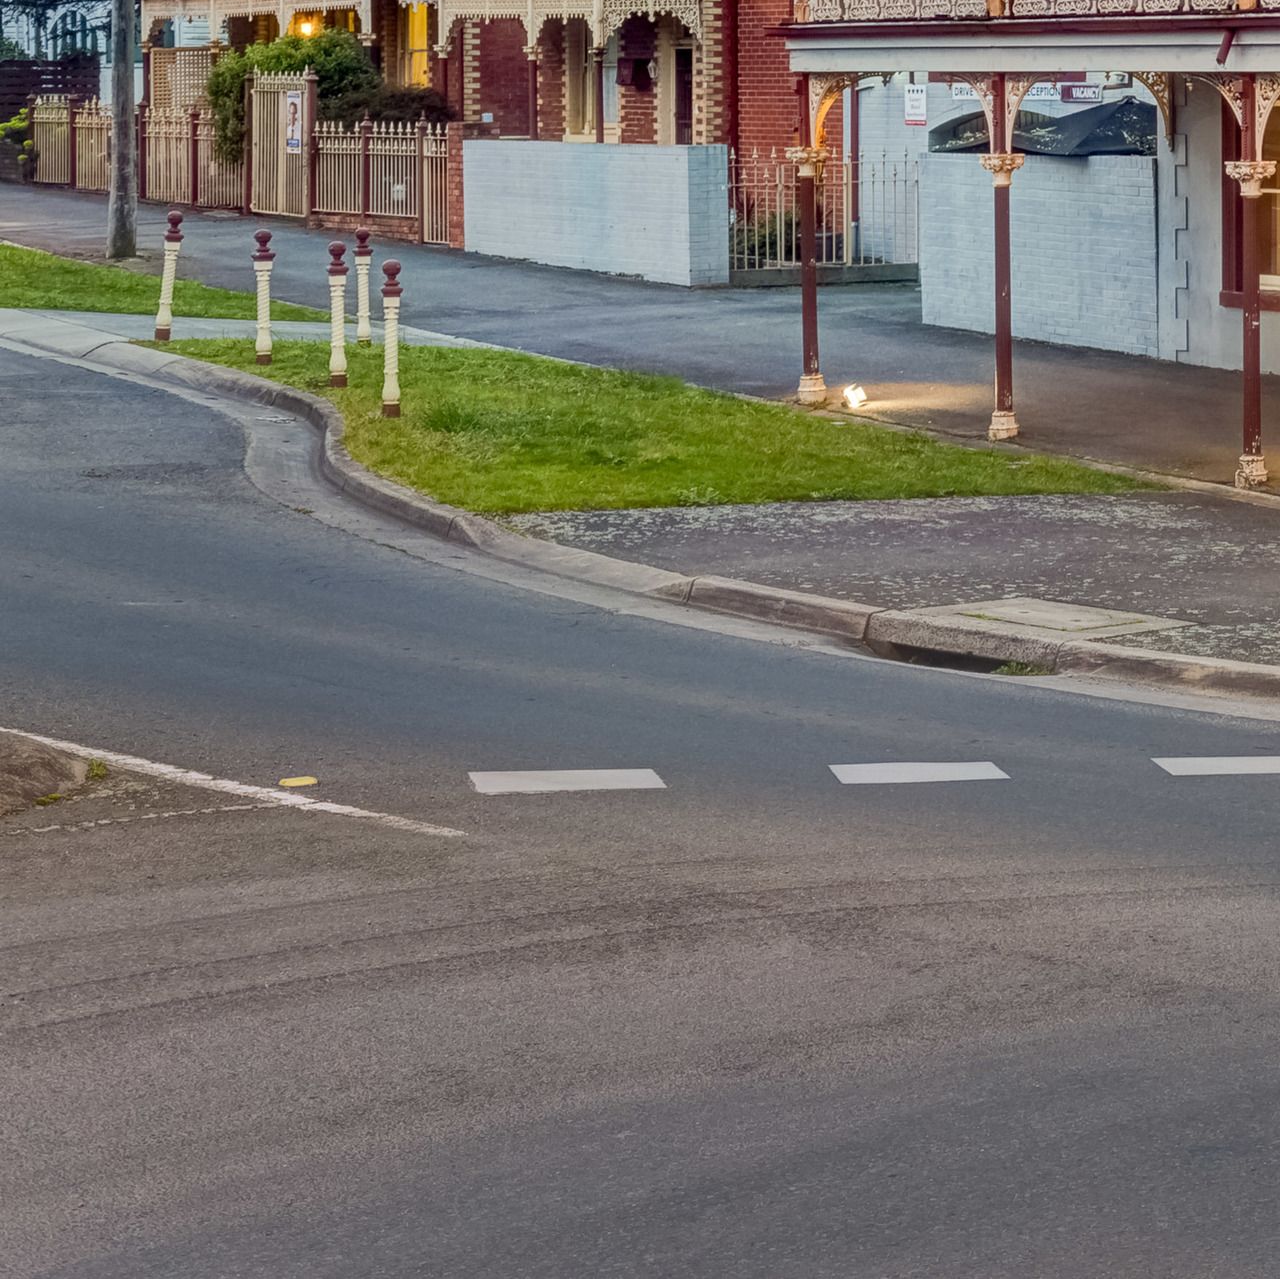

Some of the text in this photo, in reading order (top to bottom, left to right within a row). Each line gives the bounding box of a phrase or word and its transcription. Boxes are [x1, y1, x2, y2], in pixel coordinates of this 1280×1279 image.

[954, 86, 974, 97] DRIVE
[1026, 86, 1061, 97] ECEPTION
[1071, 87, 1100, 99] VACANCY
